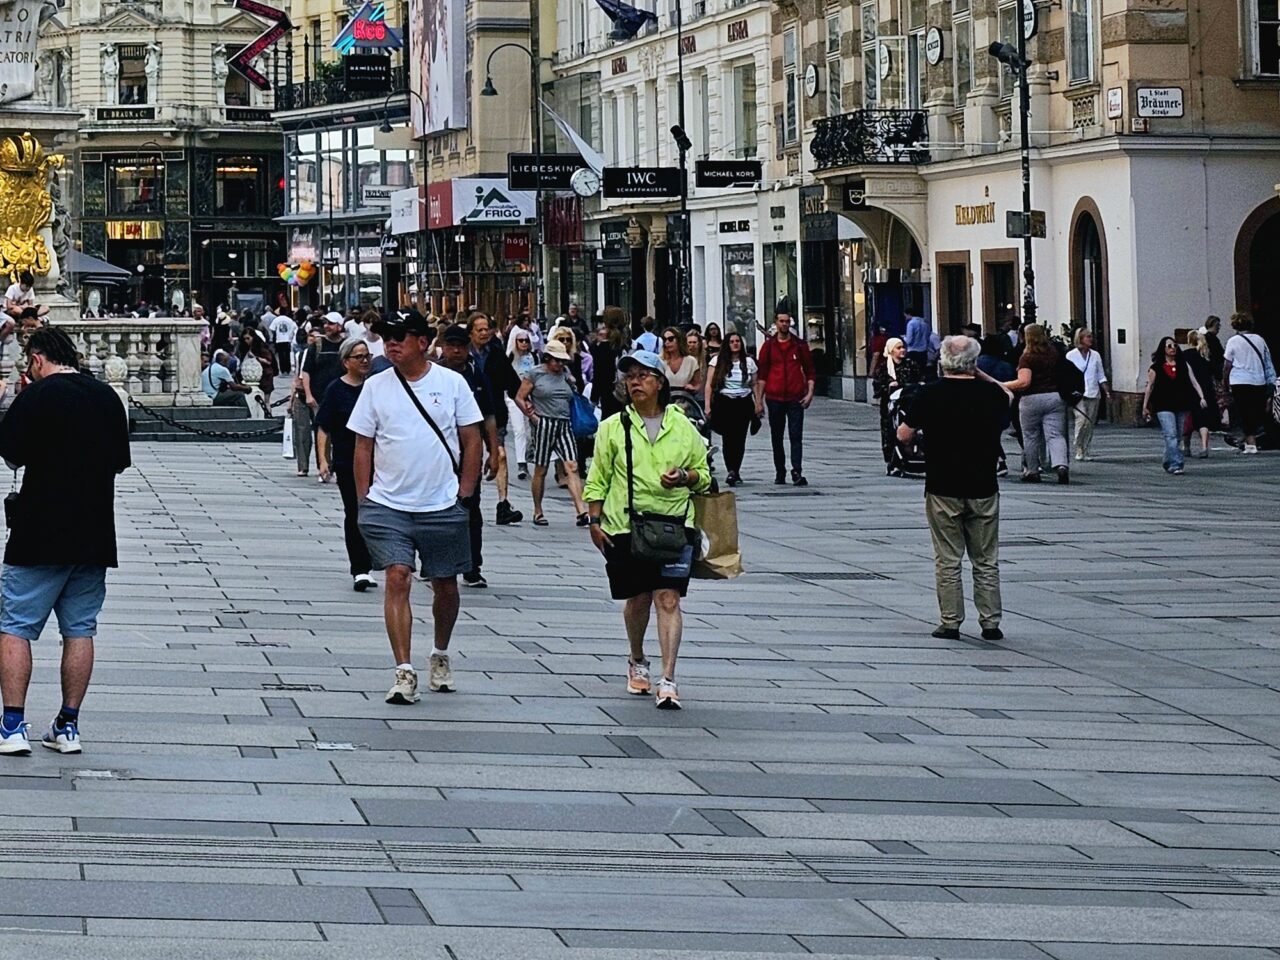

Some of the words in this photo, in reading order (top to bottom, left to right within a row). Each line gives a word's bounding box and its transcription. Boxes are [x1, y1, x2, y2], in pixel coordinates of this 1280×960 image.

[626, 172, 657, 185] IWC
[704, 170, 734, 178] MICHAEL
[735, 170, 756, 178] KORS
[485, 209, 522, 218] FRIGO
